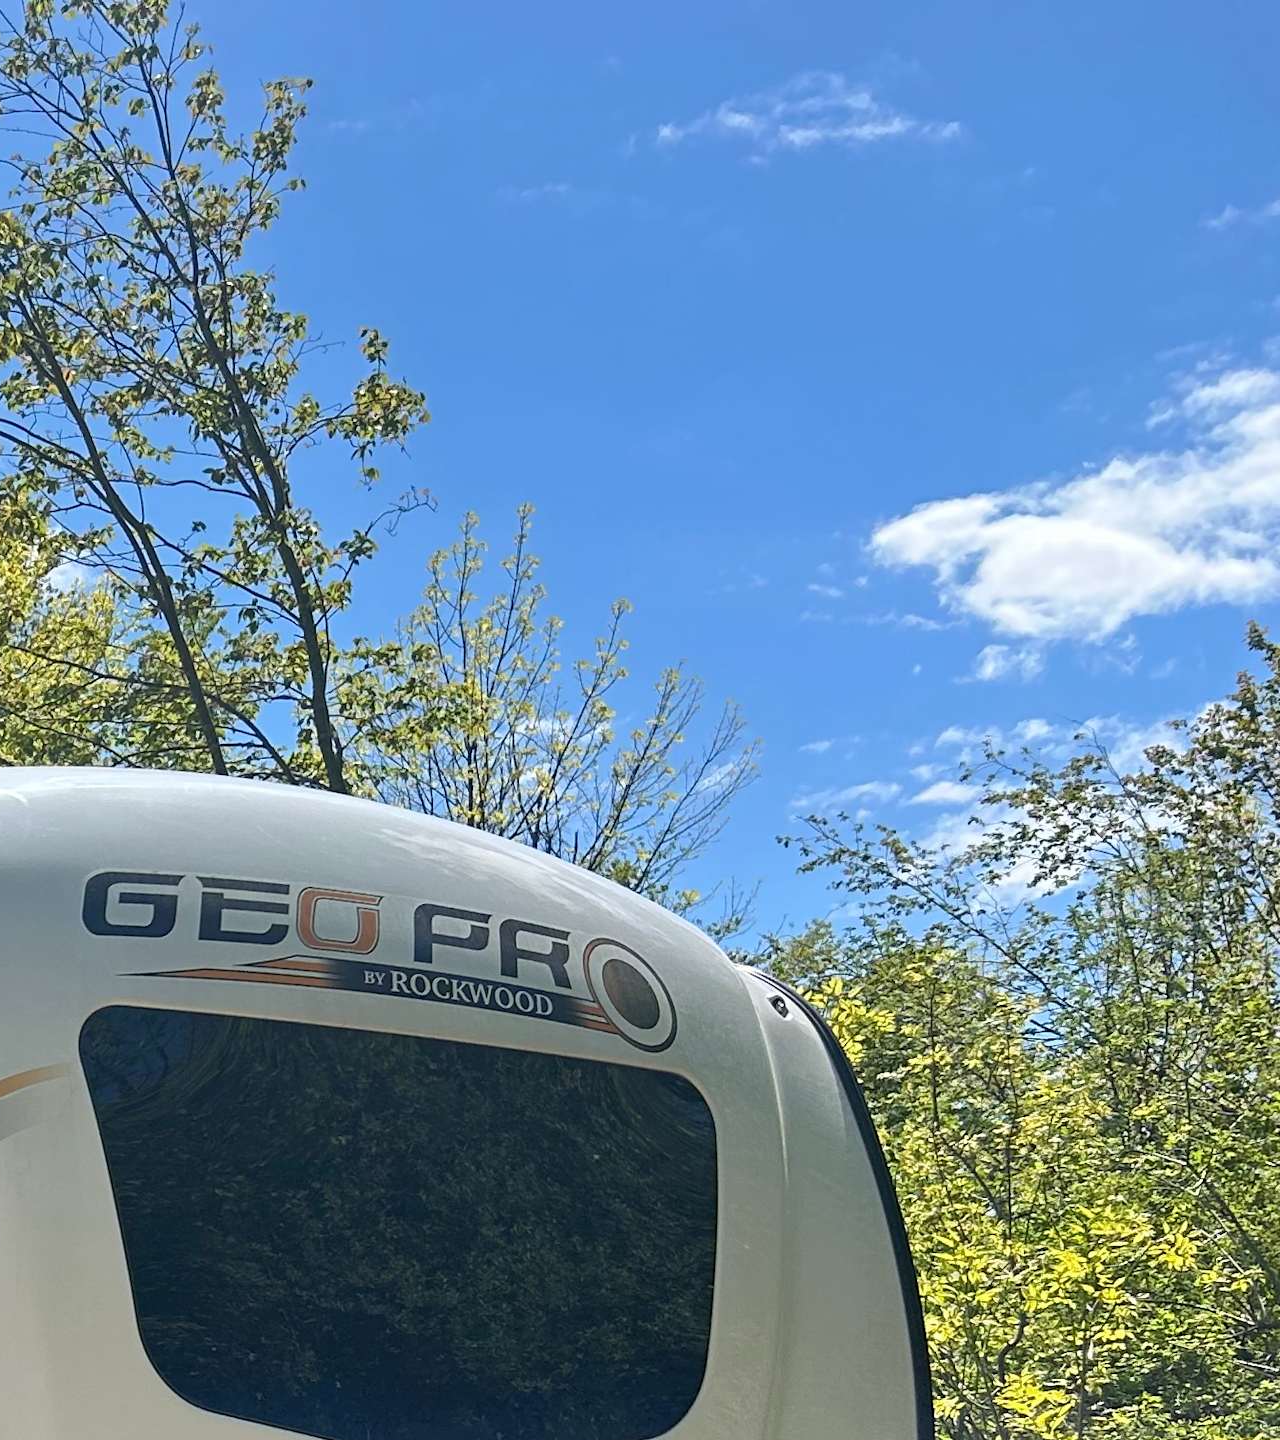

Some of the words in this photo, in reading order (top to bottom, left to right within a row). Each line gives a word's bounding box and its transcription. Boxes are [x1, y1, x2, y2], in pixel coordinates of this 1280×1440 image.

[82, 871, 384, 955] GEO
[413, 903, 678, 1053] PRO
[363, 970, 386, 986] BY
[390, 970, 554, 1017] ROCKWOOD
